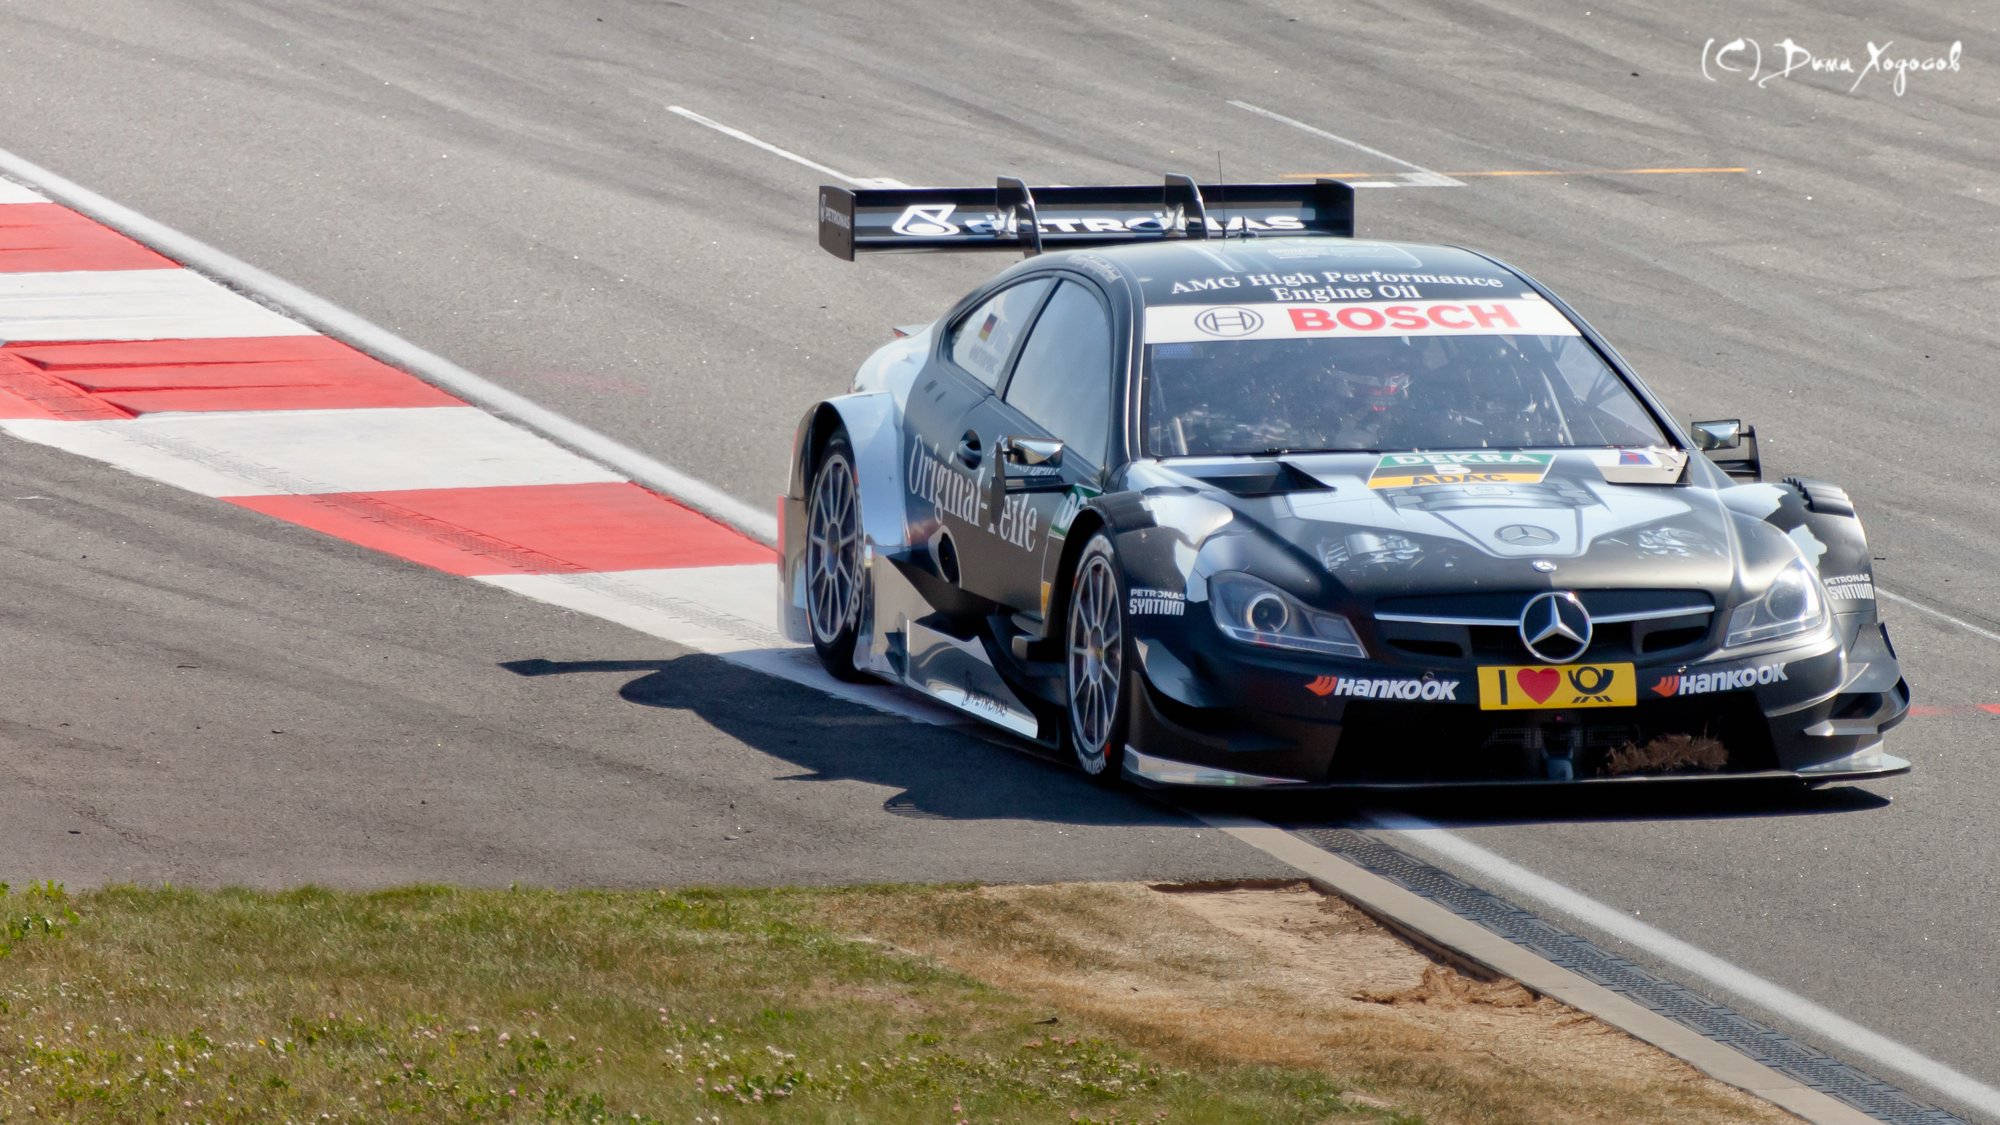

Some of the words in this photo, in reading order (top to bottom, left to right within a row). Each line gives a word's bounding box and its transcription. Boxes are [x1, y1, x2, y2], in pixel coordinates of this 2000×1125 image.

[1171, 276, 1241, 294] AMG
[1246, 273, 1318, 287] High
[1319, 271, 1504, 288] Performance
[1271, 284, 1373, 302] Engine
[1378, 284, 1423, 299] Oil
[1286, 305, 1521, 331] BOSCH
[1391, 453, 1541, 465] DEKRA
[1412, 474, 1509, 485] ADAC
[909, 434, 1038, 552] Original-eile
[1823, 574, 1871, 586] PETRONAS
[1130, 588, 1186, 600] PETRONAS
[1827, 583, 1875, 600] SYNTIUM
[1129, 598, 1185, 616] SYNTIUM
